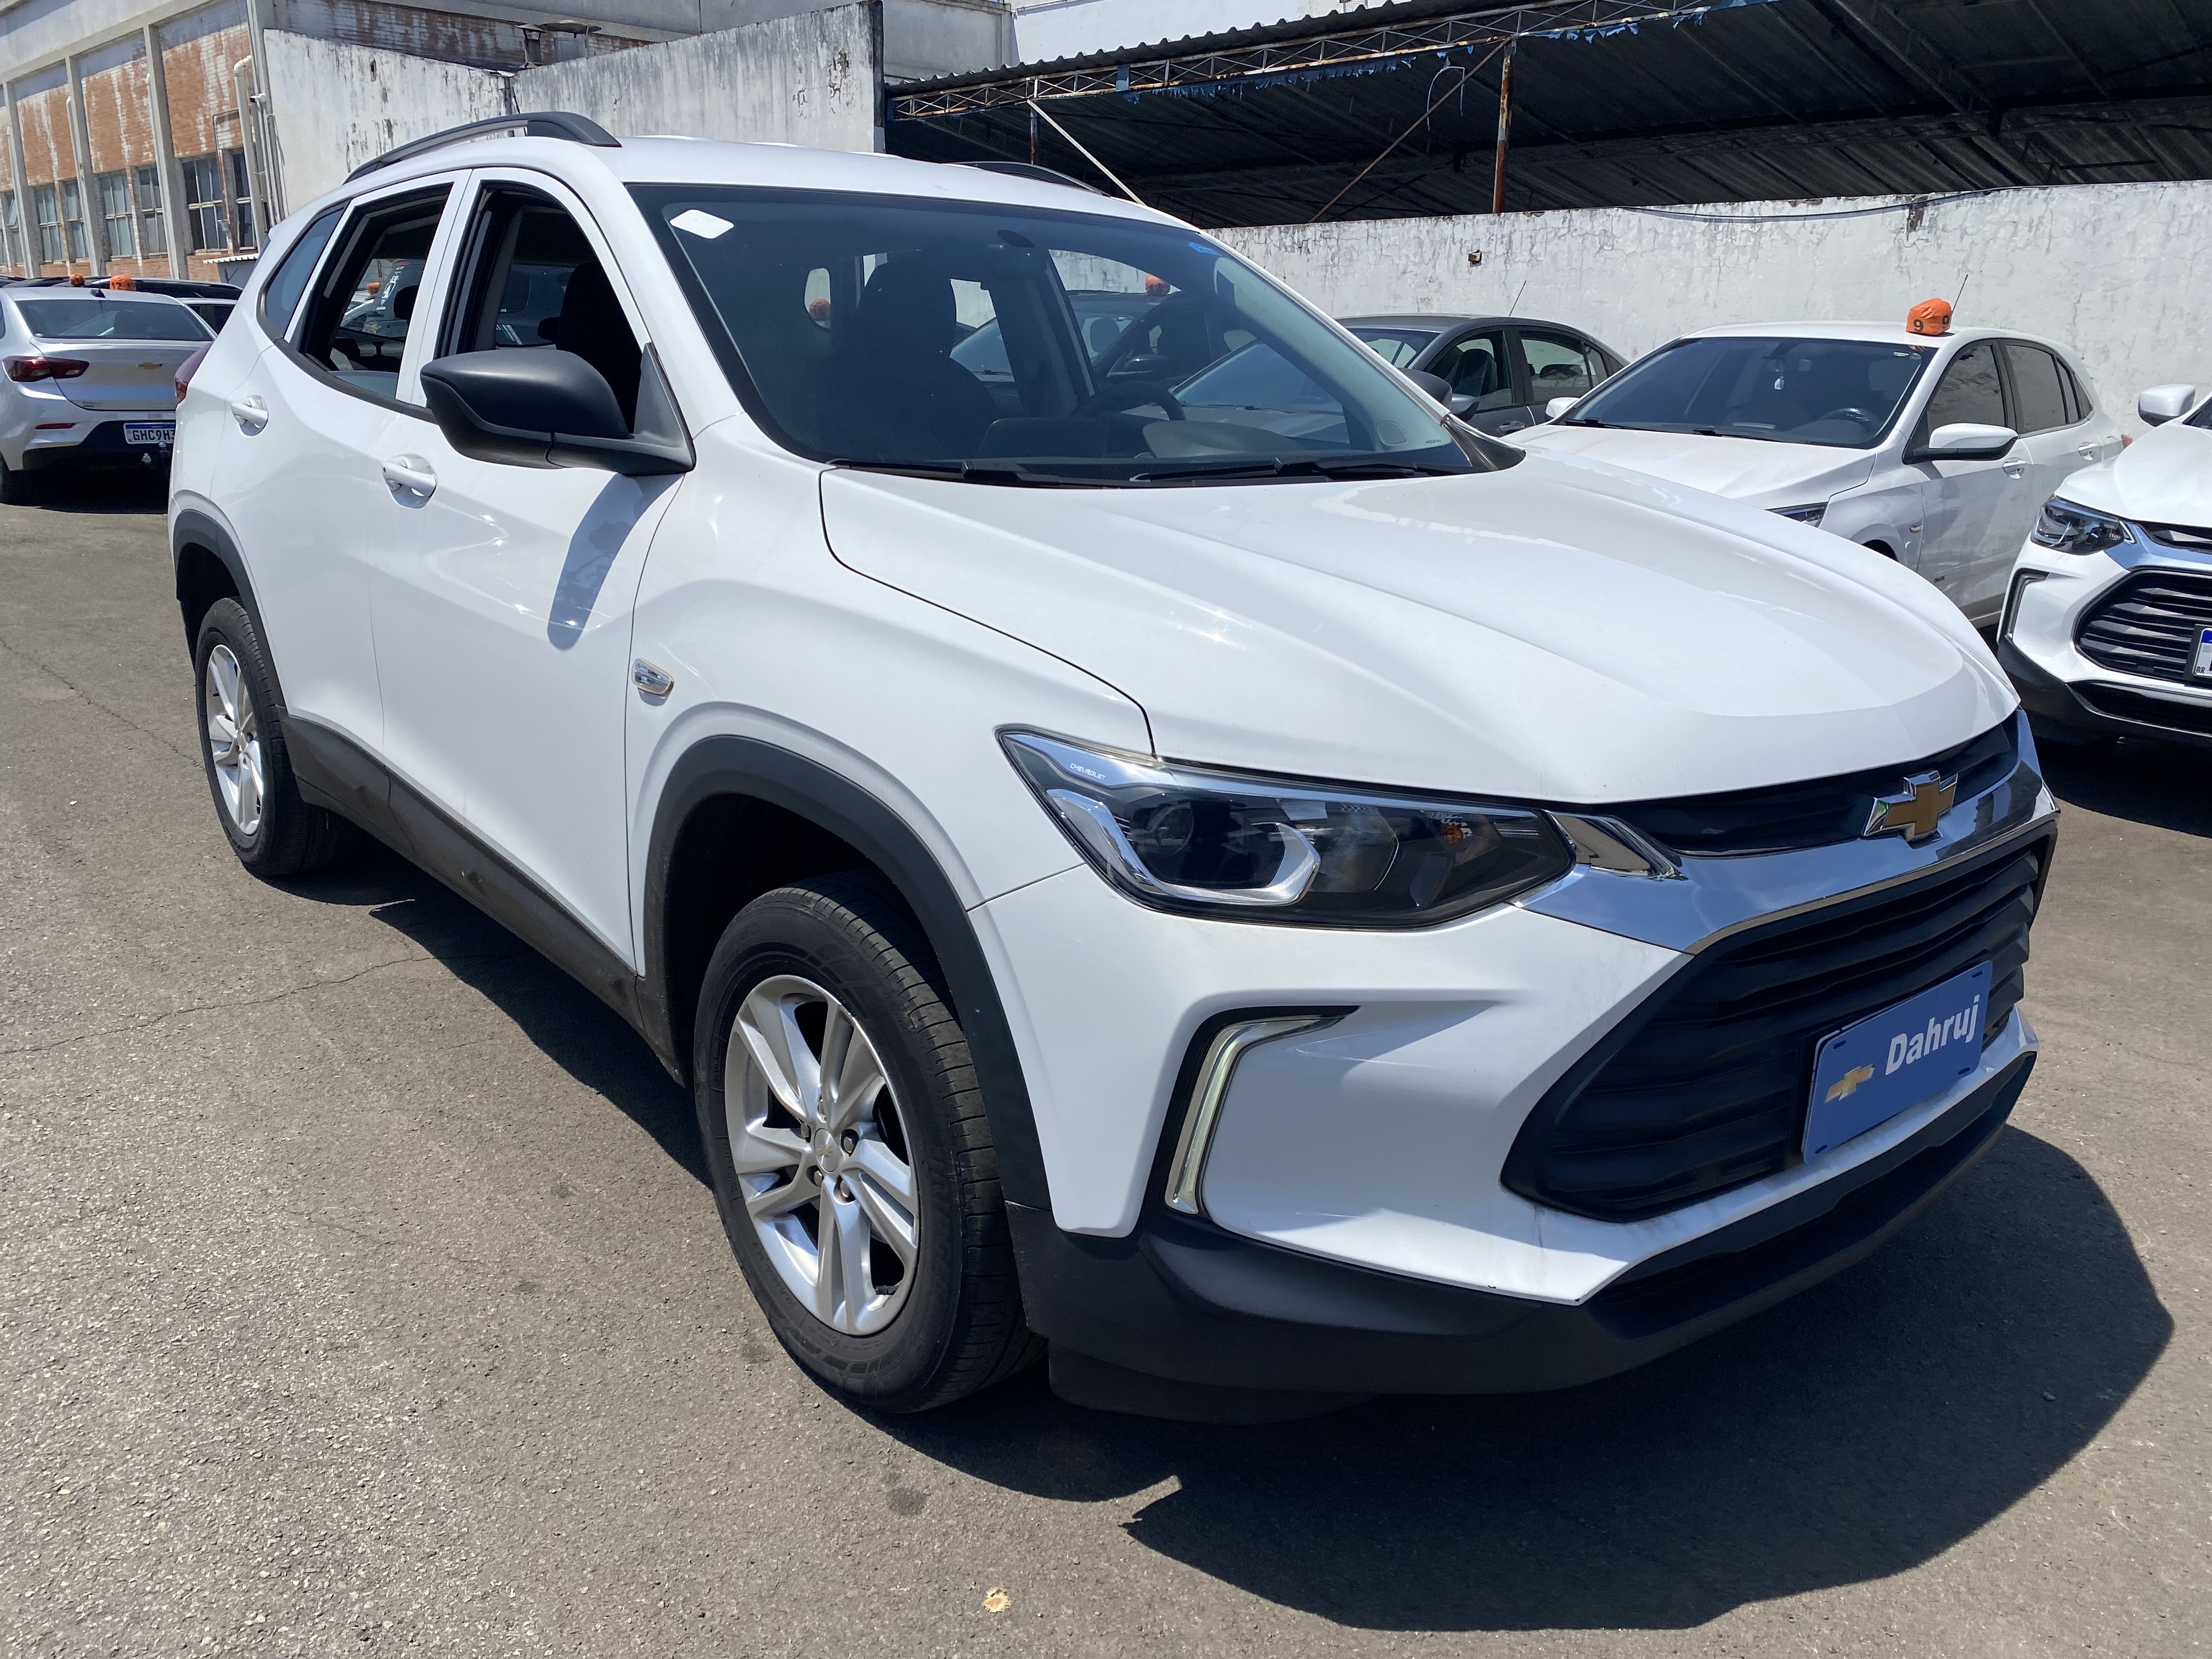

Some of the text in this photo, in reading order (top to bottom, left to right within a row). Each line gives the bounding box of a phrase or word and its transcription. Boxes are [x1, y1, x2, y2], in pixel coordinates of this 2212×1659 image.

[1912, 319, 1924, 332] 9
[1070, 763, 1107, 780] CHEVROLET
[1885, 994, 1980, 1076] Dahruj
